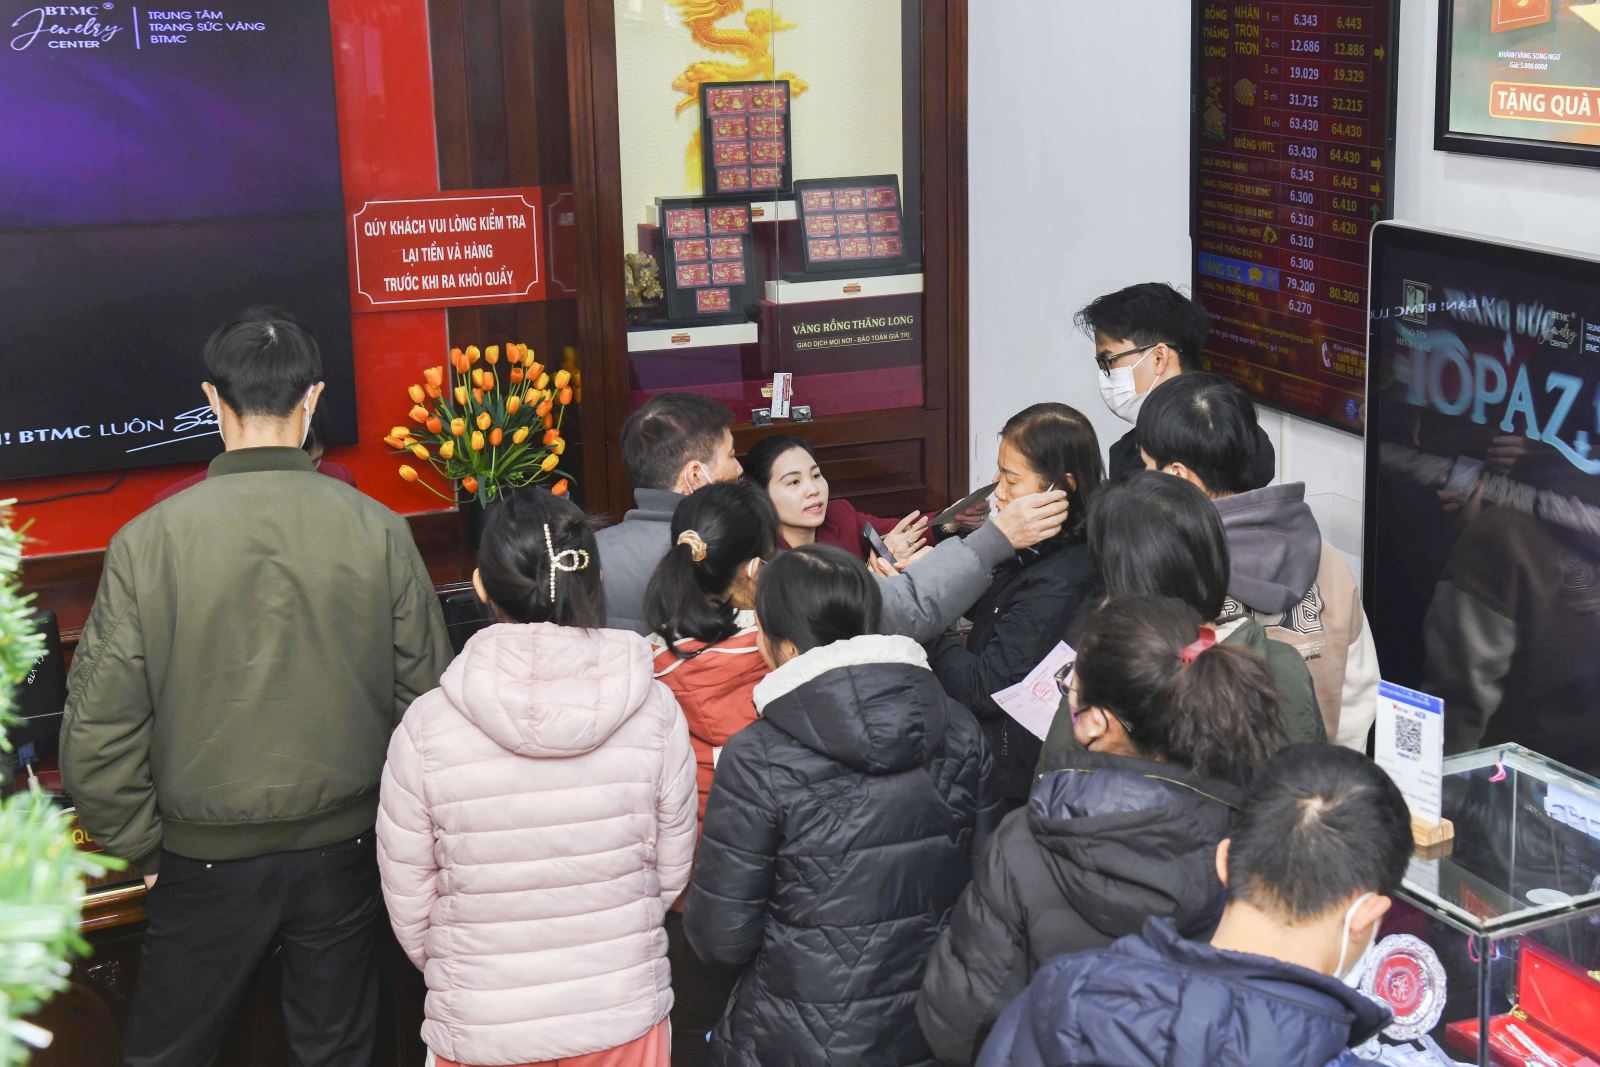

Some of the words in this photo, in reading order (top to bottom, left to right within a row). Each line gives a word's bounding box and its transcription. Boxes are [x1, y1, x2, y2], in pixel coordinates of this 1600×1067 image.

[45, 6, 99, 15] BTMC
[148, 11, 192, 20] TRUNG
[195, 9, 223, 19] TÂM
[149, 23, 193, 31] TRANG
[197, 20, 222, 31] SỨC
[226, 20, 265, 31] VÀNG
[1293, 14, 1318, 27] 6.343
[1336, 16, 1362, 30] 6.443
[11, 8, 123, 51] Jewelry
[150, 35, 187, 44] BTMC
[1290, 39, 1320, 53] 12.686
[1204, 46, 1227, 58] LONG
[1334, 42, 1365, 56] 12.886
[1290, 66, 1319, 80] 19.029
[1333, 68, 1365, 82] 19.329
[1289, 93, 1318, 108] 31.715
[1332, 97, 1363, 112] 32.215
[1498, 87, 1545, 116] TẶNG
[1550, 92, 1592, 117] QUÀ
[1263, 115, 1271, 127] 10
[1289, 117, 1319, 132] 63.430
[1331, 123, 1362, 138] 64.430
[1288, 144, 1318, 160] 63.430
[1329, 148, 1360, 164] 64.430
[1290, 168, 1314, 182] 6.343
[1332, 175, 1358, 189] 6.443
[1289, 190, 1313, 205] 6.300
[1332, 197, 1357, 213] 6.410
[390, 216, 426, 235] KHÁCH
[428, 218, 447, 233] VUI
[449, 214, 476, 232] LÒNG
[479, 208, 504, 230] KIỂM
[506, 214, 526, 229] TRA
[1290, 212, 1314, 227] 6.310
[1332, 219, 1357, 235] 6.420
[1290, 234, 1314, 249] 6.310
[402, 248, 418, 267] LẠI
[421, 241, 444, 262] TIỀN
[447, 241, 462, 260] VÀ
[464, 241, 493, 259] HÀNG
[1290, 256, 1314, 271] 6.300
[384, 272, 419, 292] TRƯỚC
[421, 275, 438, 290] KHI
[441, 274, 455, 288] RA
[458, 267, 483, 287] KHỎI
[485, 264, 513, 285] QUẦY
[1286, 276, 1316, 294] 79.200
[1329, 287, 1360, 304] 80.300
[1288, 299, 1312, 315] 6.270
[793, 322, 820, 335] VÀNG
[823, 318, 851, 332] RỒNG
[852, 317, 886, 329] THĂNG
[888, 315, 914, 326] LONG
[797, 341, 812, 349] GIAO
[19, 425, 92, 444] BTMC
[100, 418, 164, 436] LUÔN
